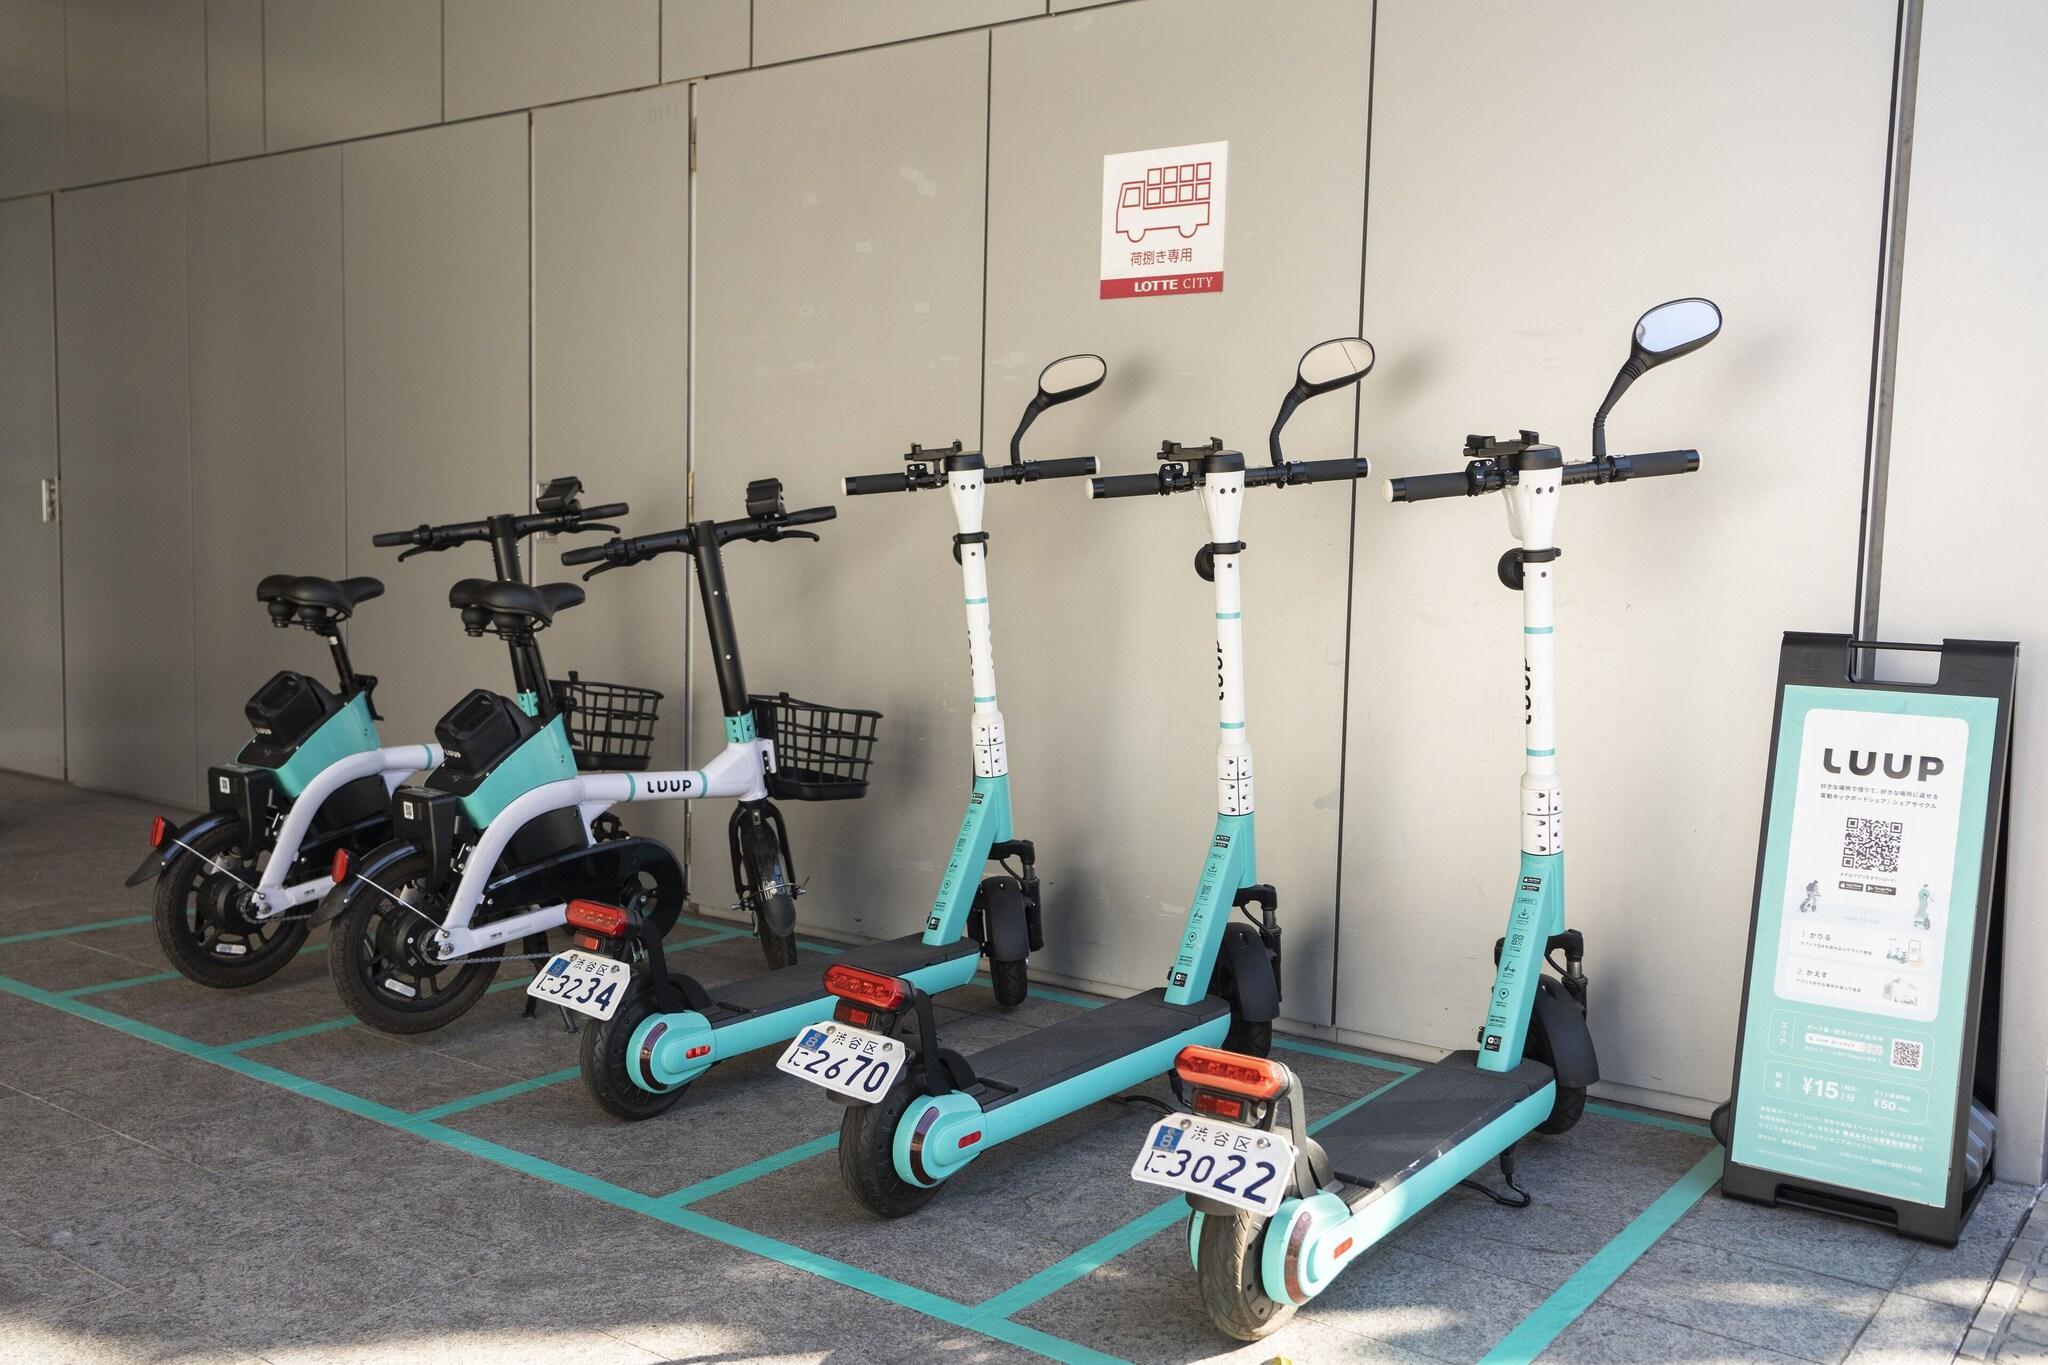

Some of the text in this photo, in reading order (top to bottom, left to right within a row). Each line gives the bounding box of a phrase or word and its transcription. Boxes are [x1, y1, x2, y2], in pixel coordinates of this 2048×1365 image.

[1130, 247, 1193, 266] 荷捌き専用
[1134, 276, 1214, 293] LOTTE CITY
[1823, 747, 1945, 782] LUUP
[647, 779, 692, 793] LUUP
[574, 958, 609, 977] 渋谷区
[832, 1032, 880, 1055] 渋谷区
[1191, 1125, 1252, 1153] 渋谷区
